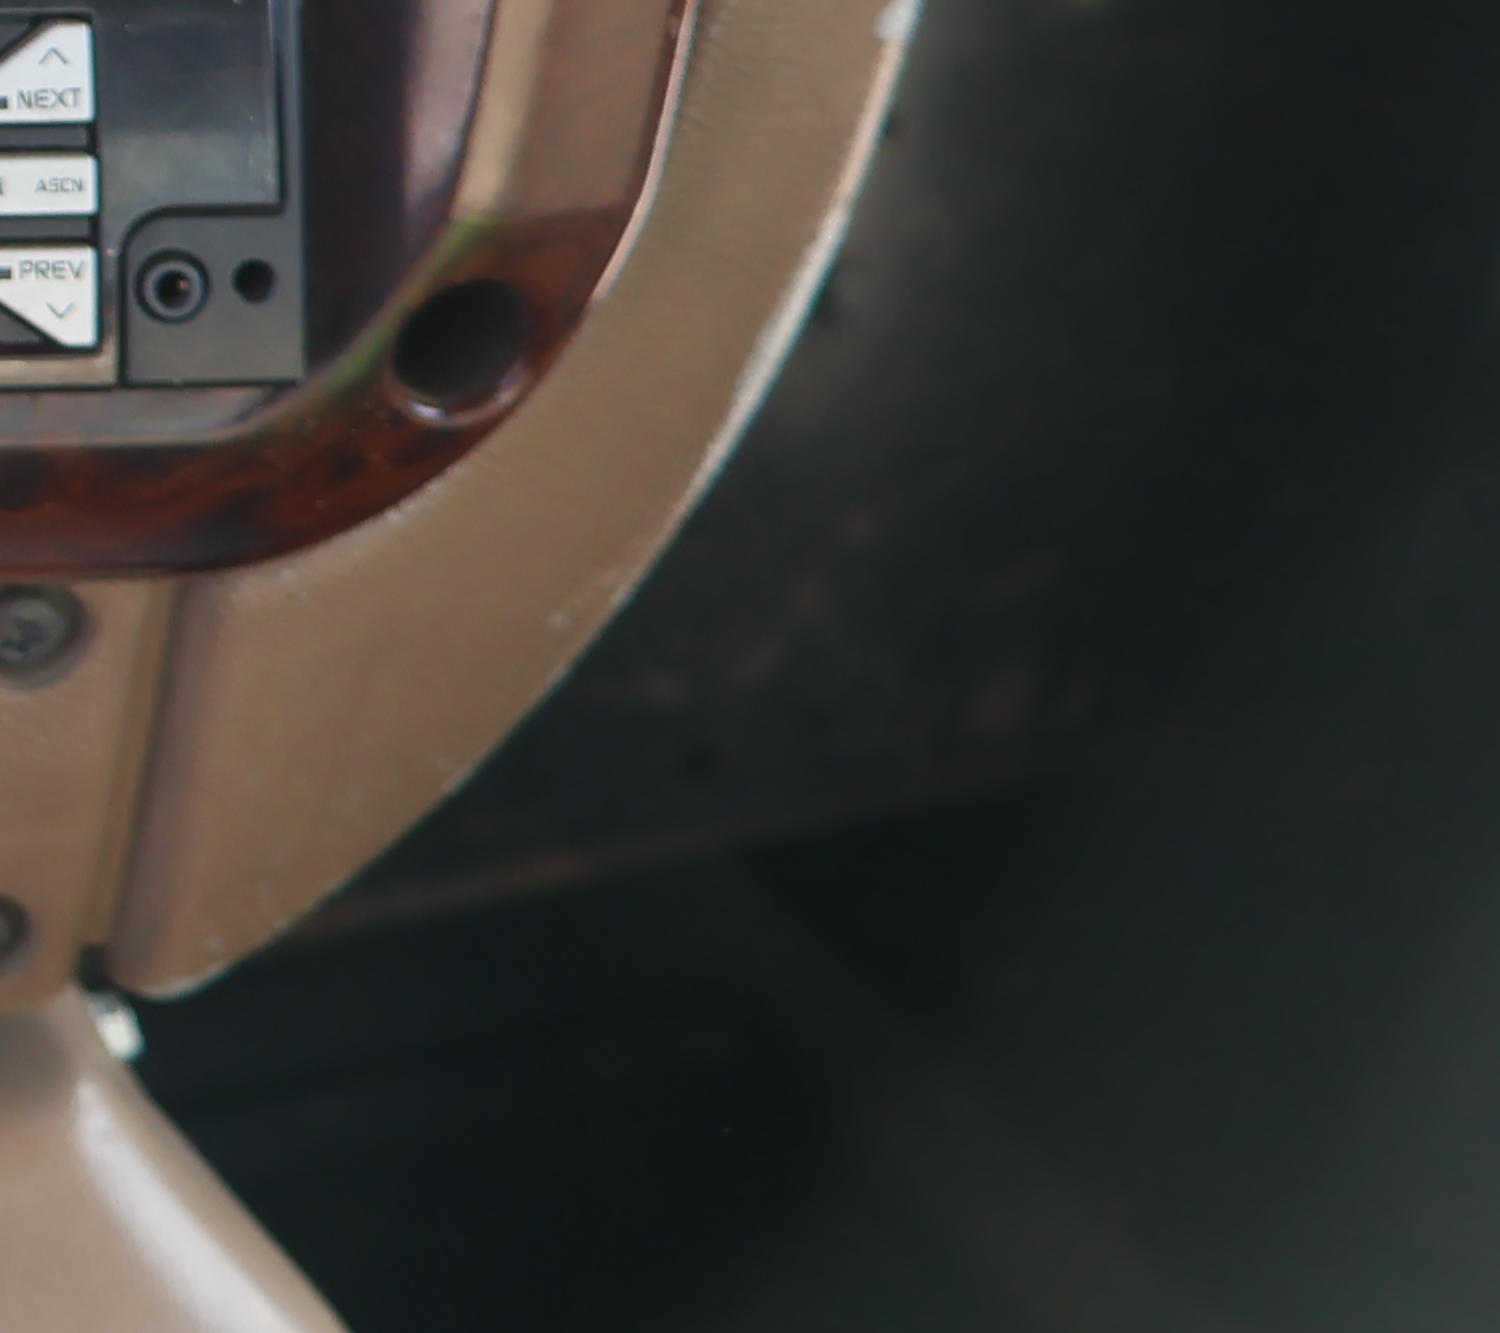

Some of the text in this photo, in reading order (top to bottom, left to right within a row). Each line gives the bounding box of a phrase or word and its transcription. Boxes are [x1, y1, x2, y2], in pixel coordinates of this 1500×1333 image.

[17, 85, 81, 111] NEXT
[35, 176, 84, 195] ASCN
[18, 258, 84, 282] PREV
